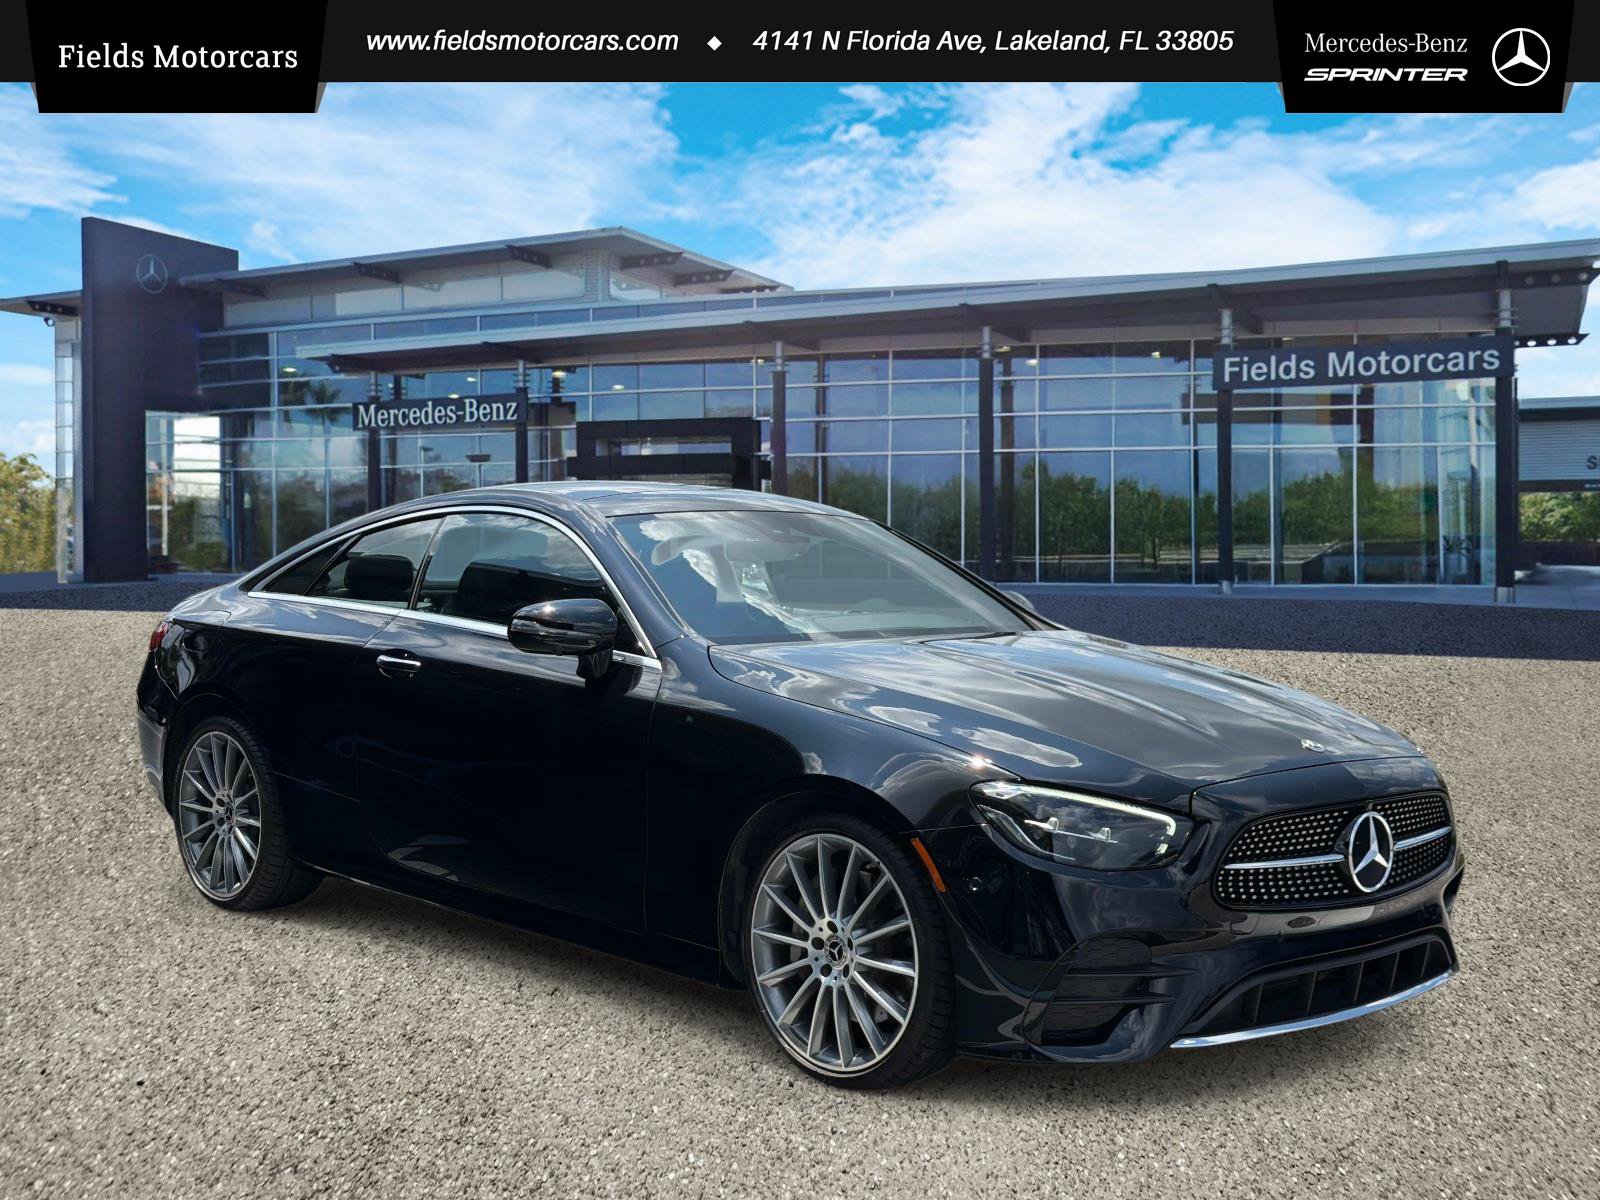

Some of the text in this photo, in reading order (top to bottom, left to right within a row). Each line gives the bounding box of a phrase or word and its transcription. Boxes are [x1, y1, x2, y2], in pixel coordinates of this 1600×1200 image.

[1224, 350, 1500, 382] Fields Motorcars
[357, 399, 518, 428] Mercedes-Benz
